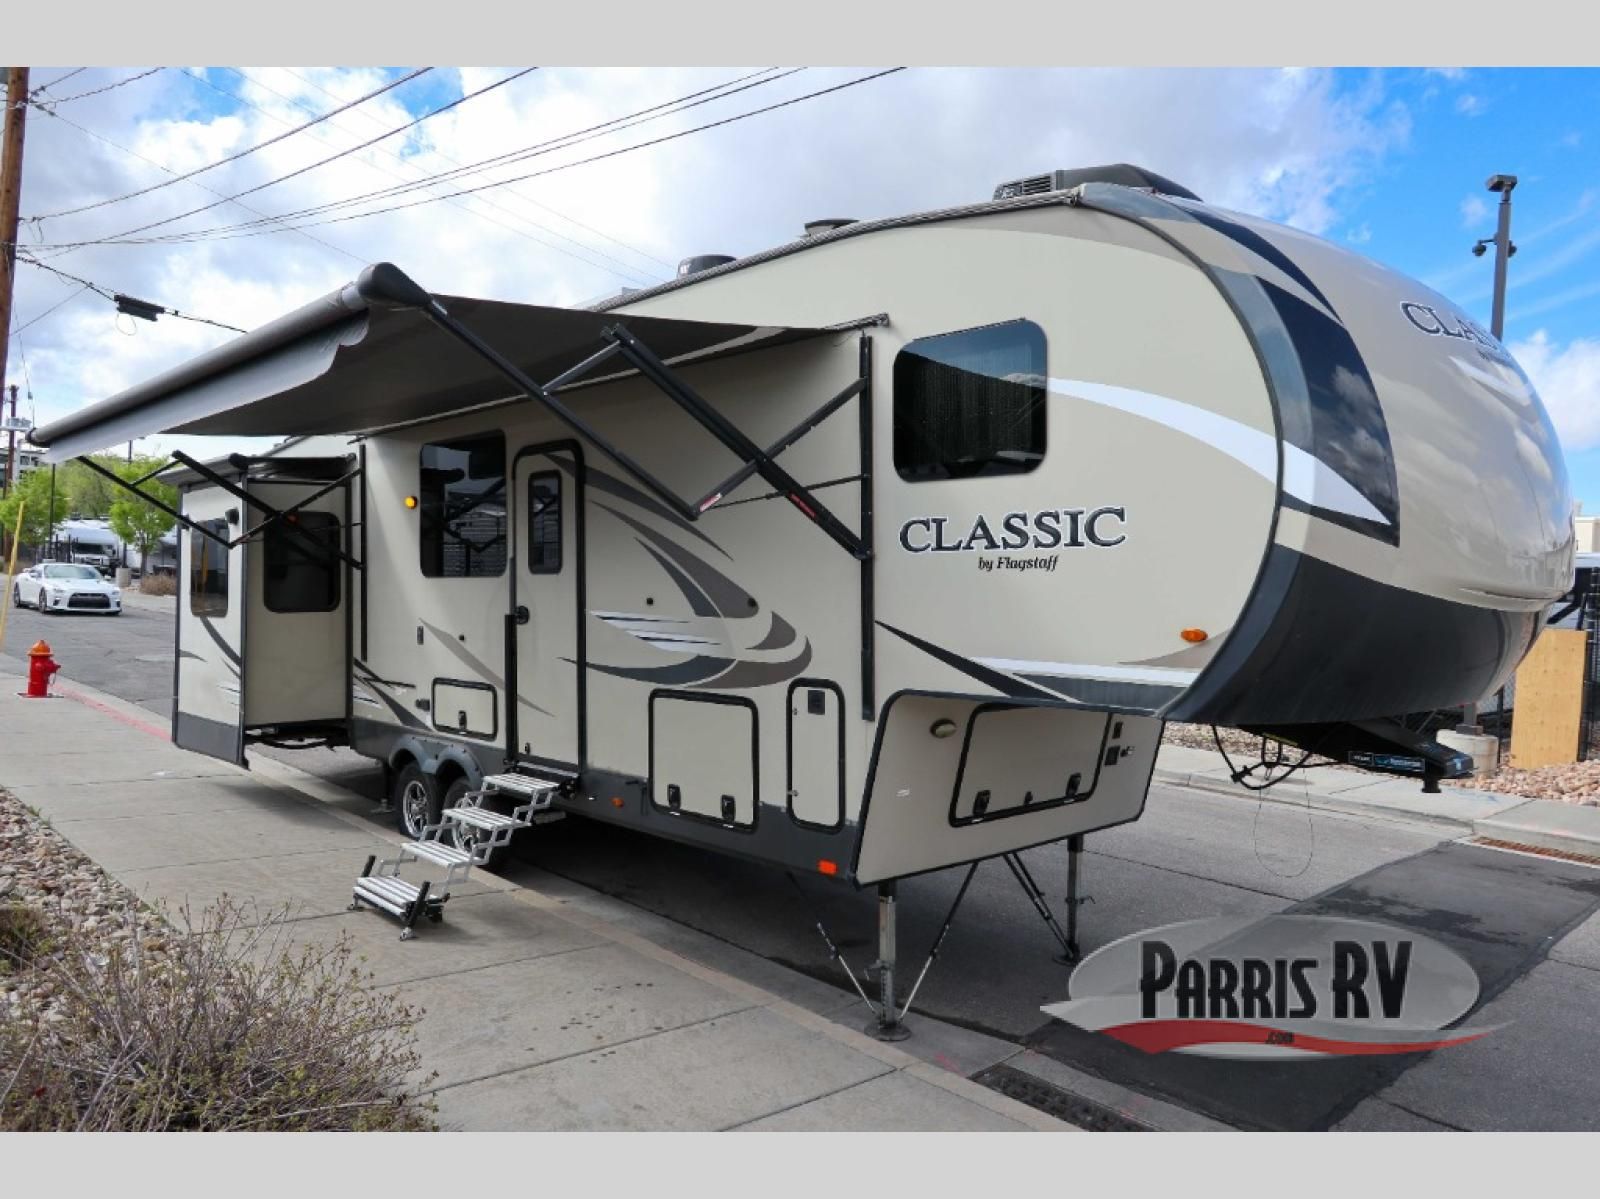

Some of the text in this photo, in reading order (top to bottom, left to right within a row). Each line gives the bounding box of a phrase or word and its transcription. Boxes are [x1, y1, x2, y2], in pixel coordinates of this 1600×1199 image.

[899, 506, 1127, 553] CLASSIC
[978, 555, 1059, 572] by Flagstaff
